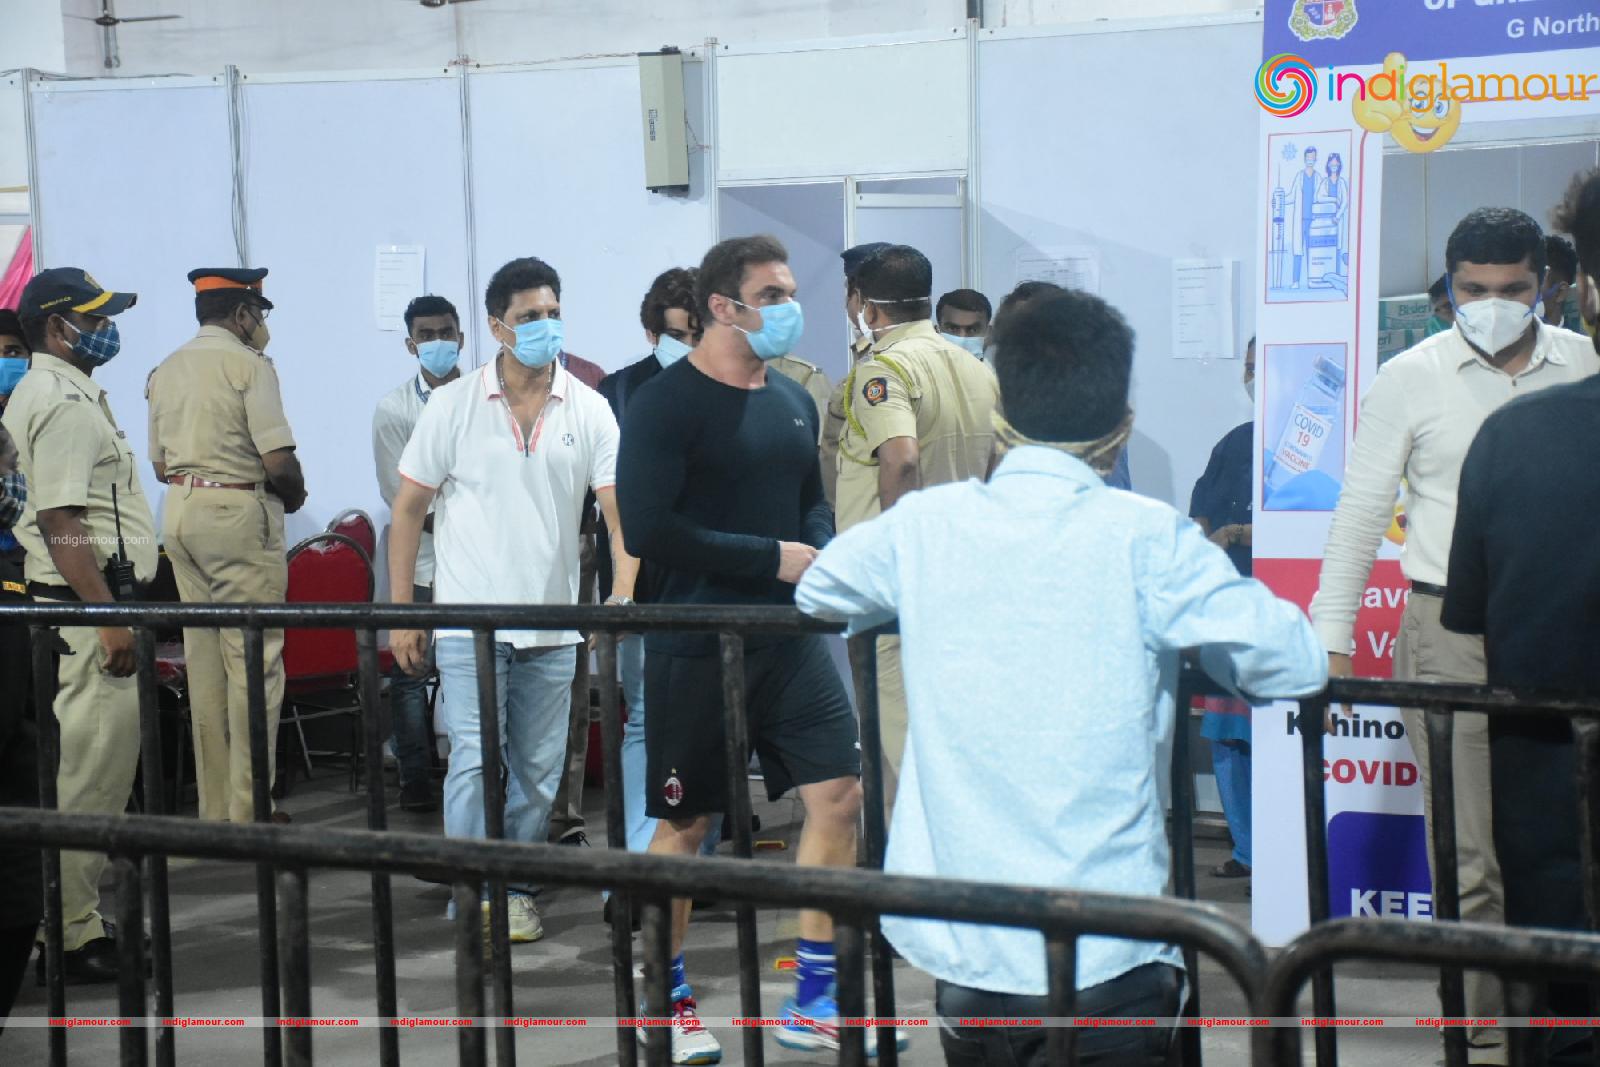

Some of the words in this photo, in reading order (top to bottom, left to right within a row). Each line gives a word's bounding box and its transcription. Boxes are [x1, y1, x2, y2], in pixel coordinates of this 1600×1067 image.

[1507, 18, 1526, 39] G
[1533, 12, 1600, 37] North
[1294, 413, 1325, 439] COVID
[1297, 431, 1311, 447] 19
[1324, 758, 1422, 786] OVID
